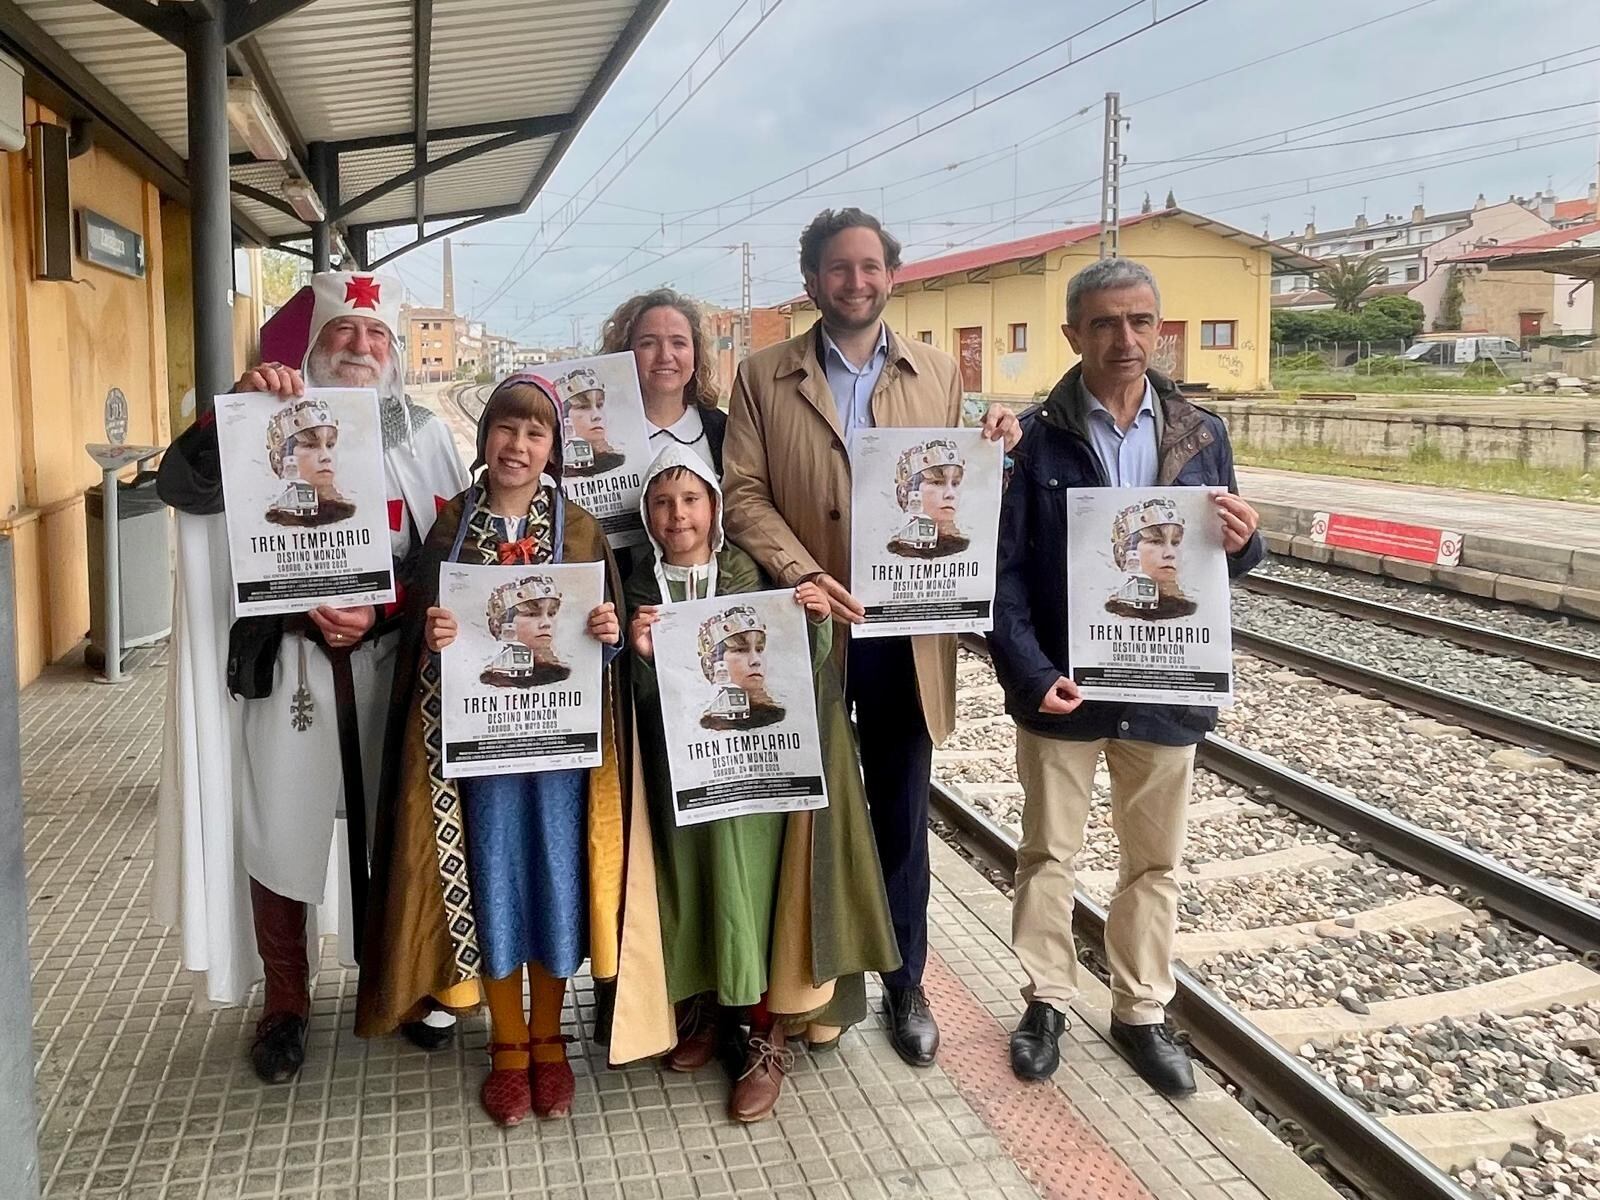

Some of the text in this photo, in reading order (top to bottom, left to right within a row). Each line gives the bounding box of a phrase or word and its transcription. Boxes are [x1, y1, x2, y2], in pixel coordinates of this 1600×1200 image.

[573, 473, 640, 497] TEMPLARIO
[592, 492, 622, 505] MONZÓN
[251, 529, 370, 553] TREN TEMPLARIO
[277, 548, 347, 564] DESTINO MONZÓN
[872, 561, 978, 581] TREN TEMPLARIO
[893, 578, 956, 592] DESTINO MONZÓN
[1089, 624, 1210, 644] TREN TEMPLARIO
[1112, 642, 1146, 654] DESTINO
[464, 691, 582, 714] TREN TEMPLARIO
[488, 708, 558, 725] DESTINO MONZÓN
[688, 732, 800, 761] TREN TEMPLARIO
[712, 754, 744, 769] DESTINO
